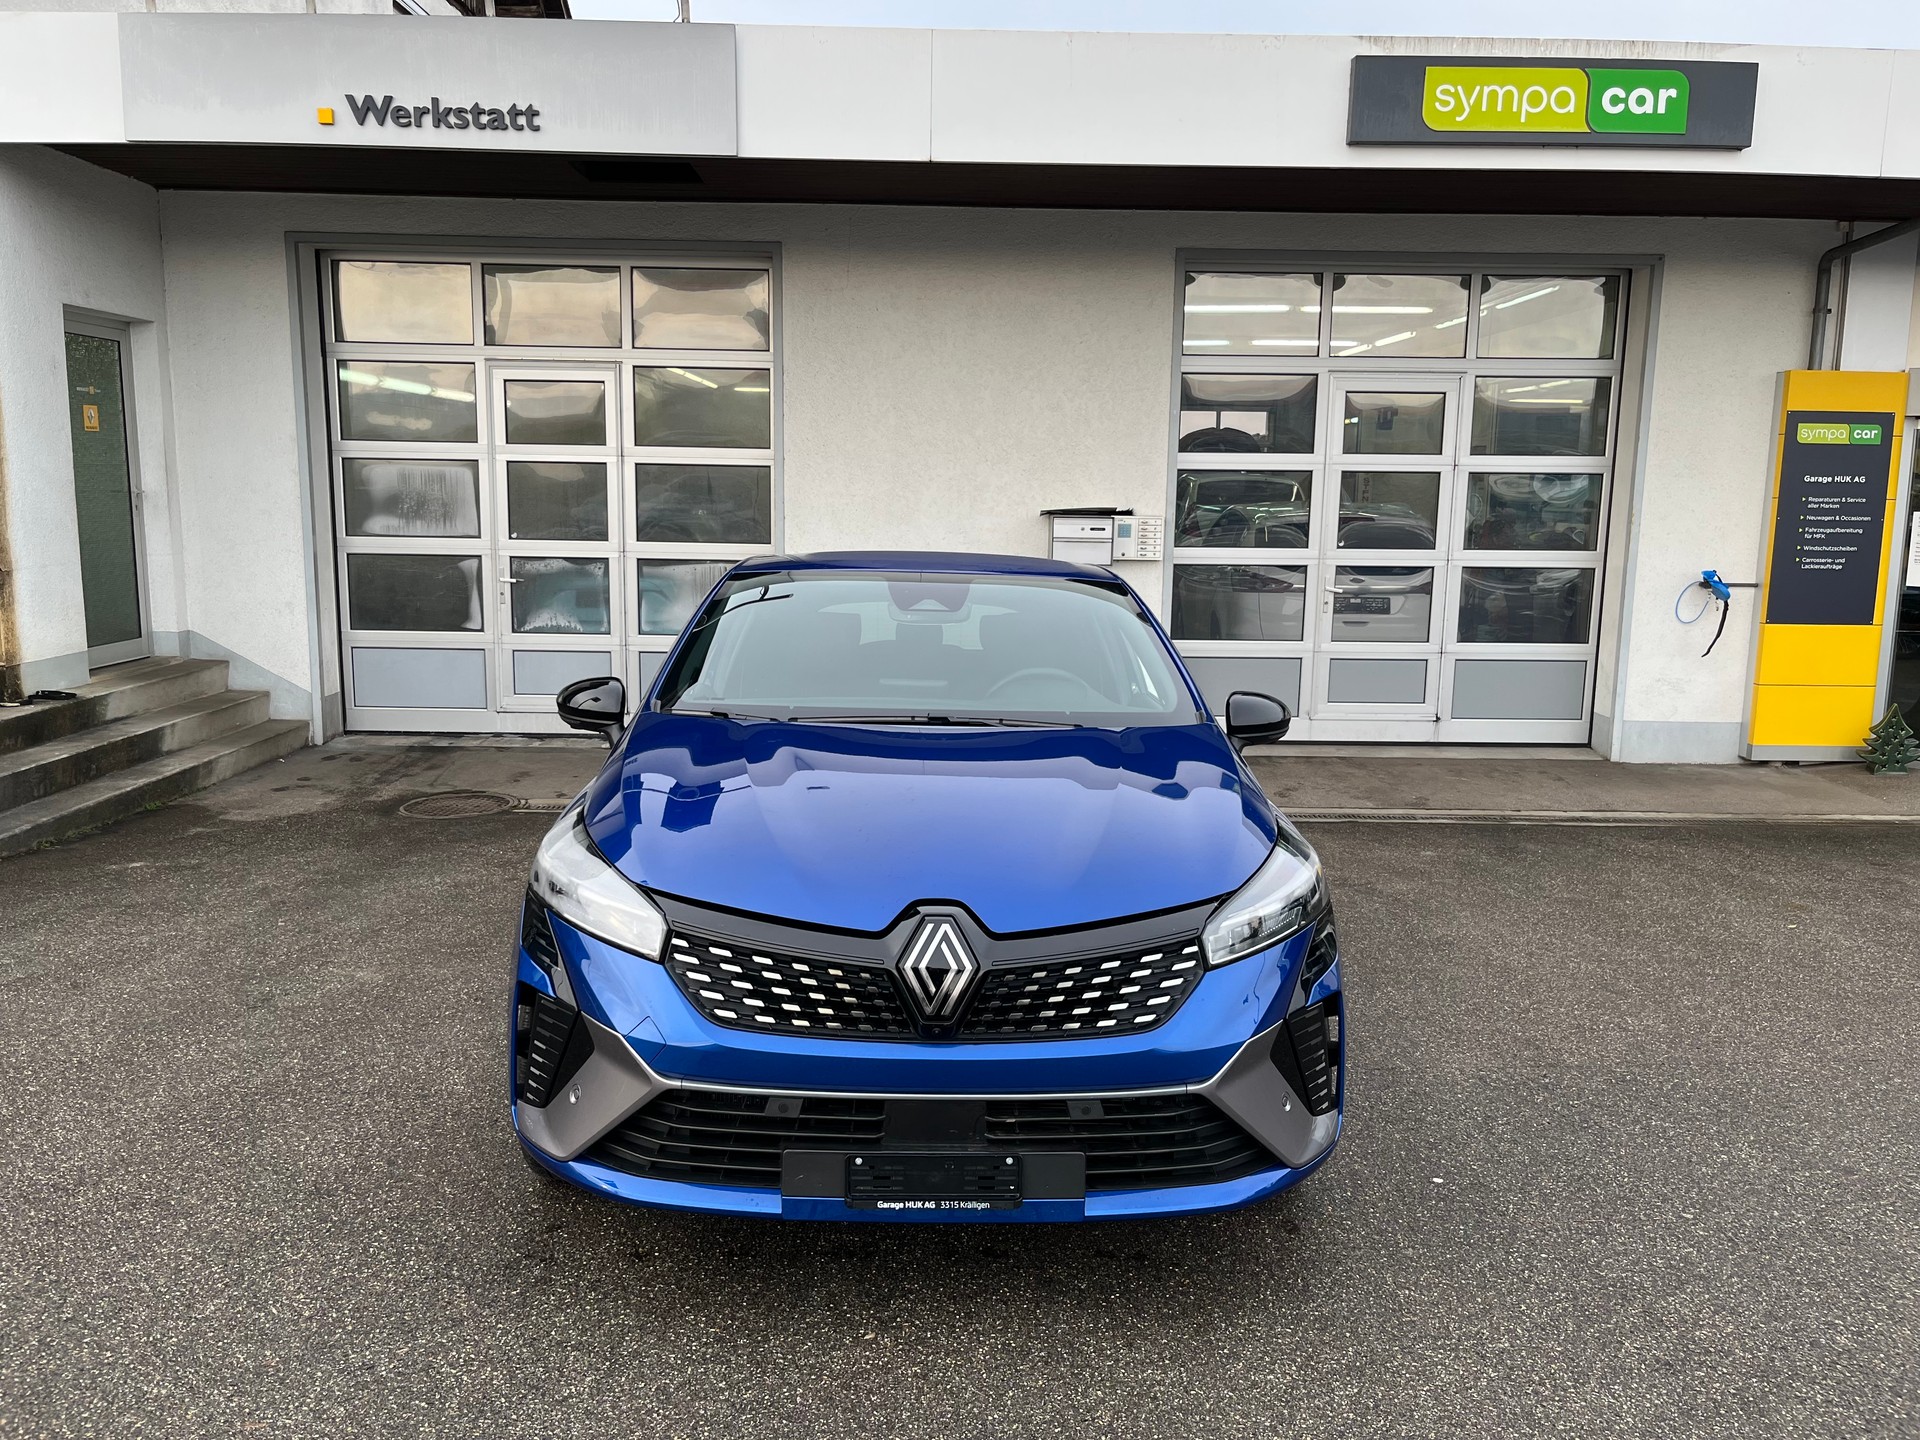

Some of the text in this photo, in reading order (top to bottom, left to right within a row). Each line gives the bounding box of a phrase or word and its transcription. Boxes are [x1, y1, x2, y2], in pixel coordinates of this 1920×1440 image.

[1434, 84, 1678, 123] sympa car
[344, 94, 541, 131] Werkstatt
[1800, 428, 1878, 441] sympa car
[1803, 475, 1866, 484] Garage HUK AG
[877, 1201, 904, 1209] Garage
